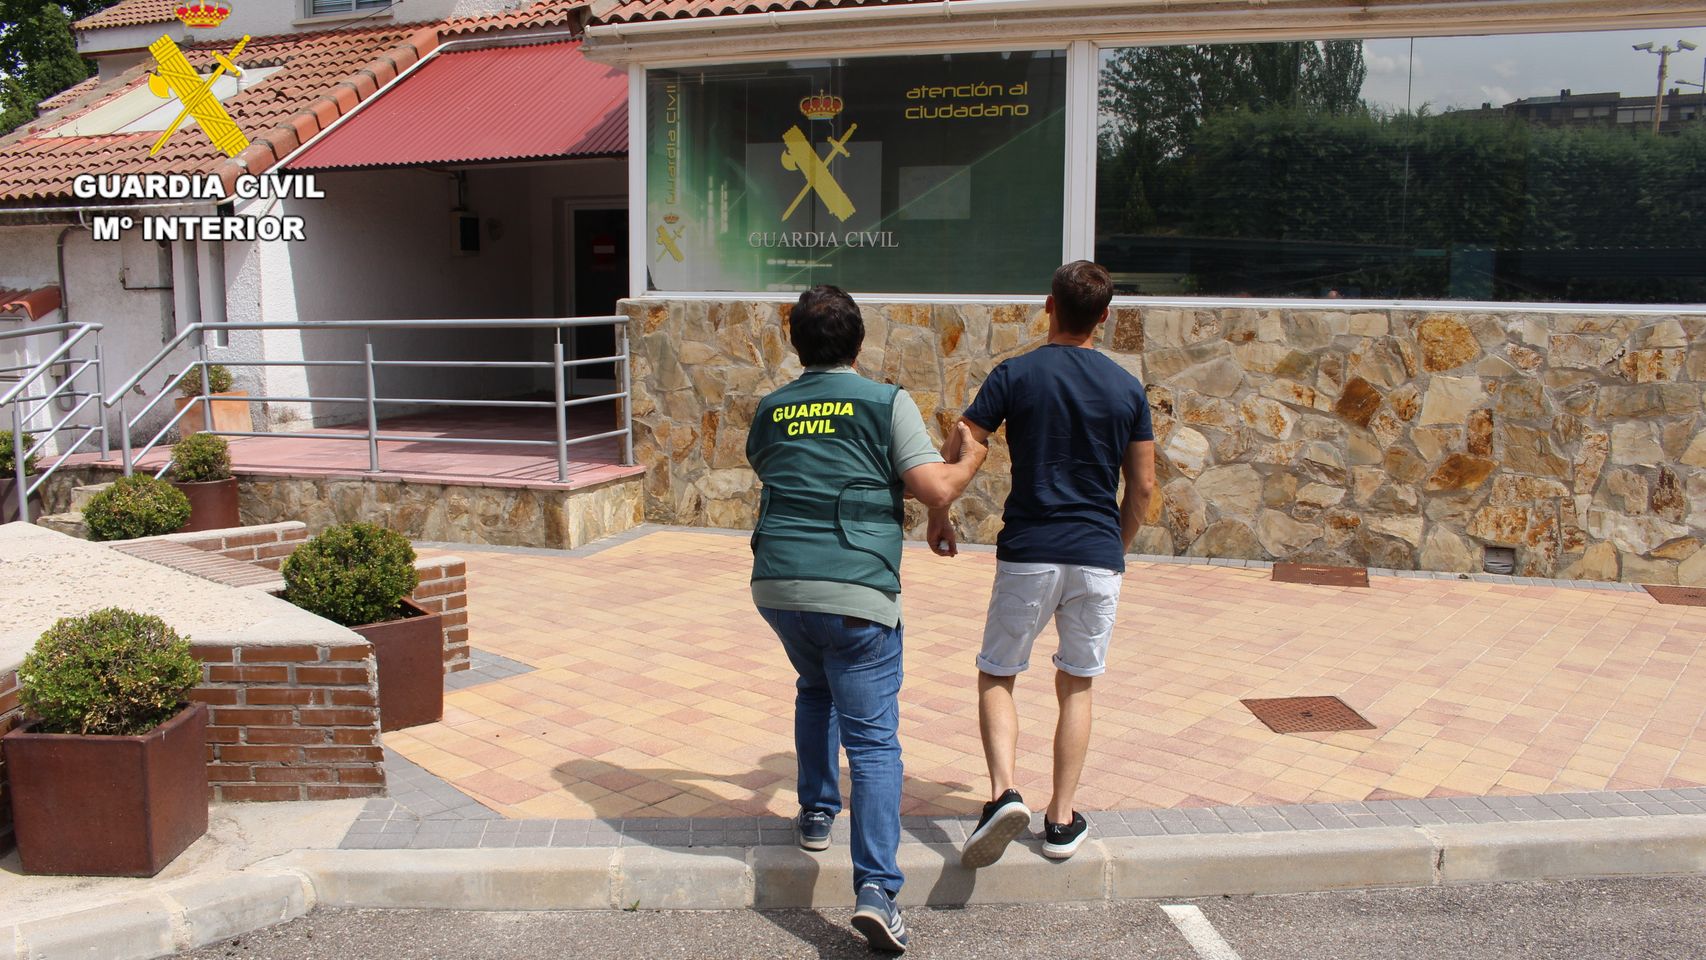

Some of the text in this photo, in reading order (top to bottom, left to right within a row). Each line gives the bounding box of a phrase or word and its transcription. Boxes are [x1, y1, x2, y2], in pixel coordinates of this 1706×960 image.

[906, 81, 1028, 99] atención al
[905, 103, 1029, 119] ciudadano
[748, 231, 900, 248] GUARDIA CIVIL
[773, 402, 854, 422] GUARDIA
[787, 419, 836, 435] CIVIL
